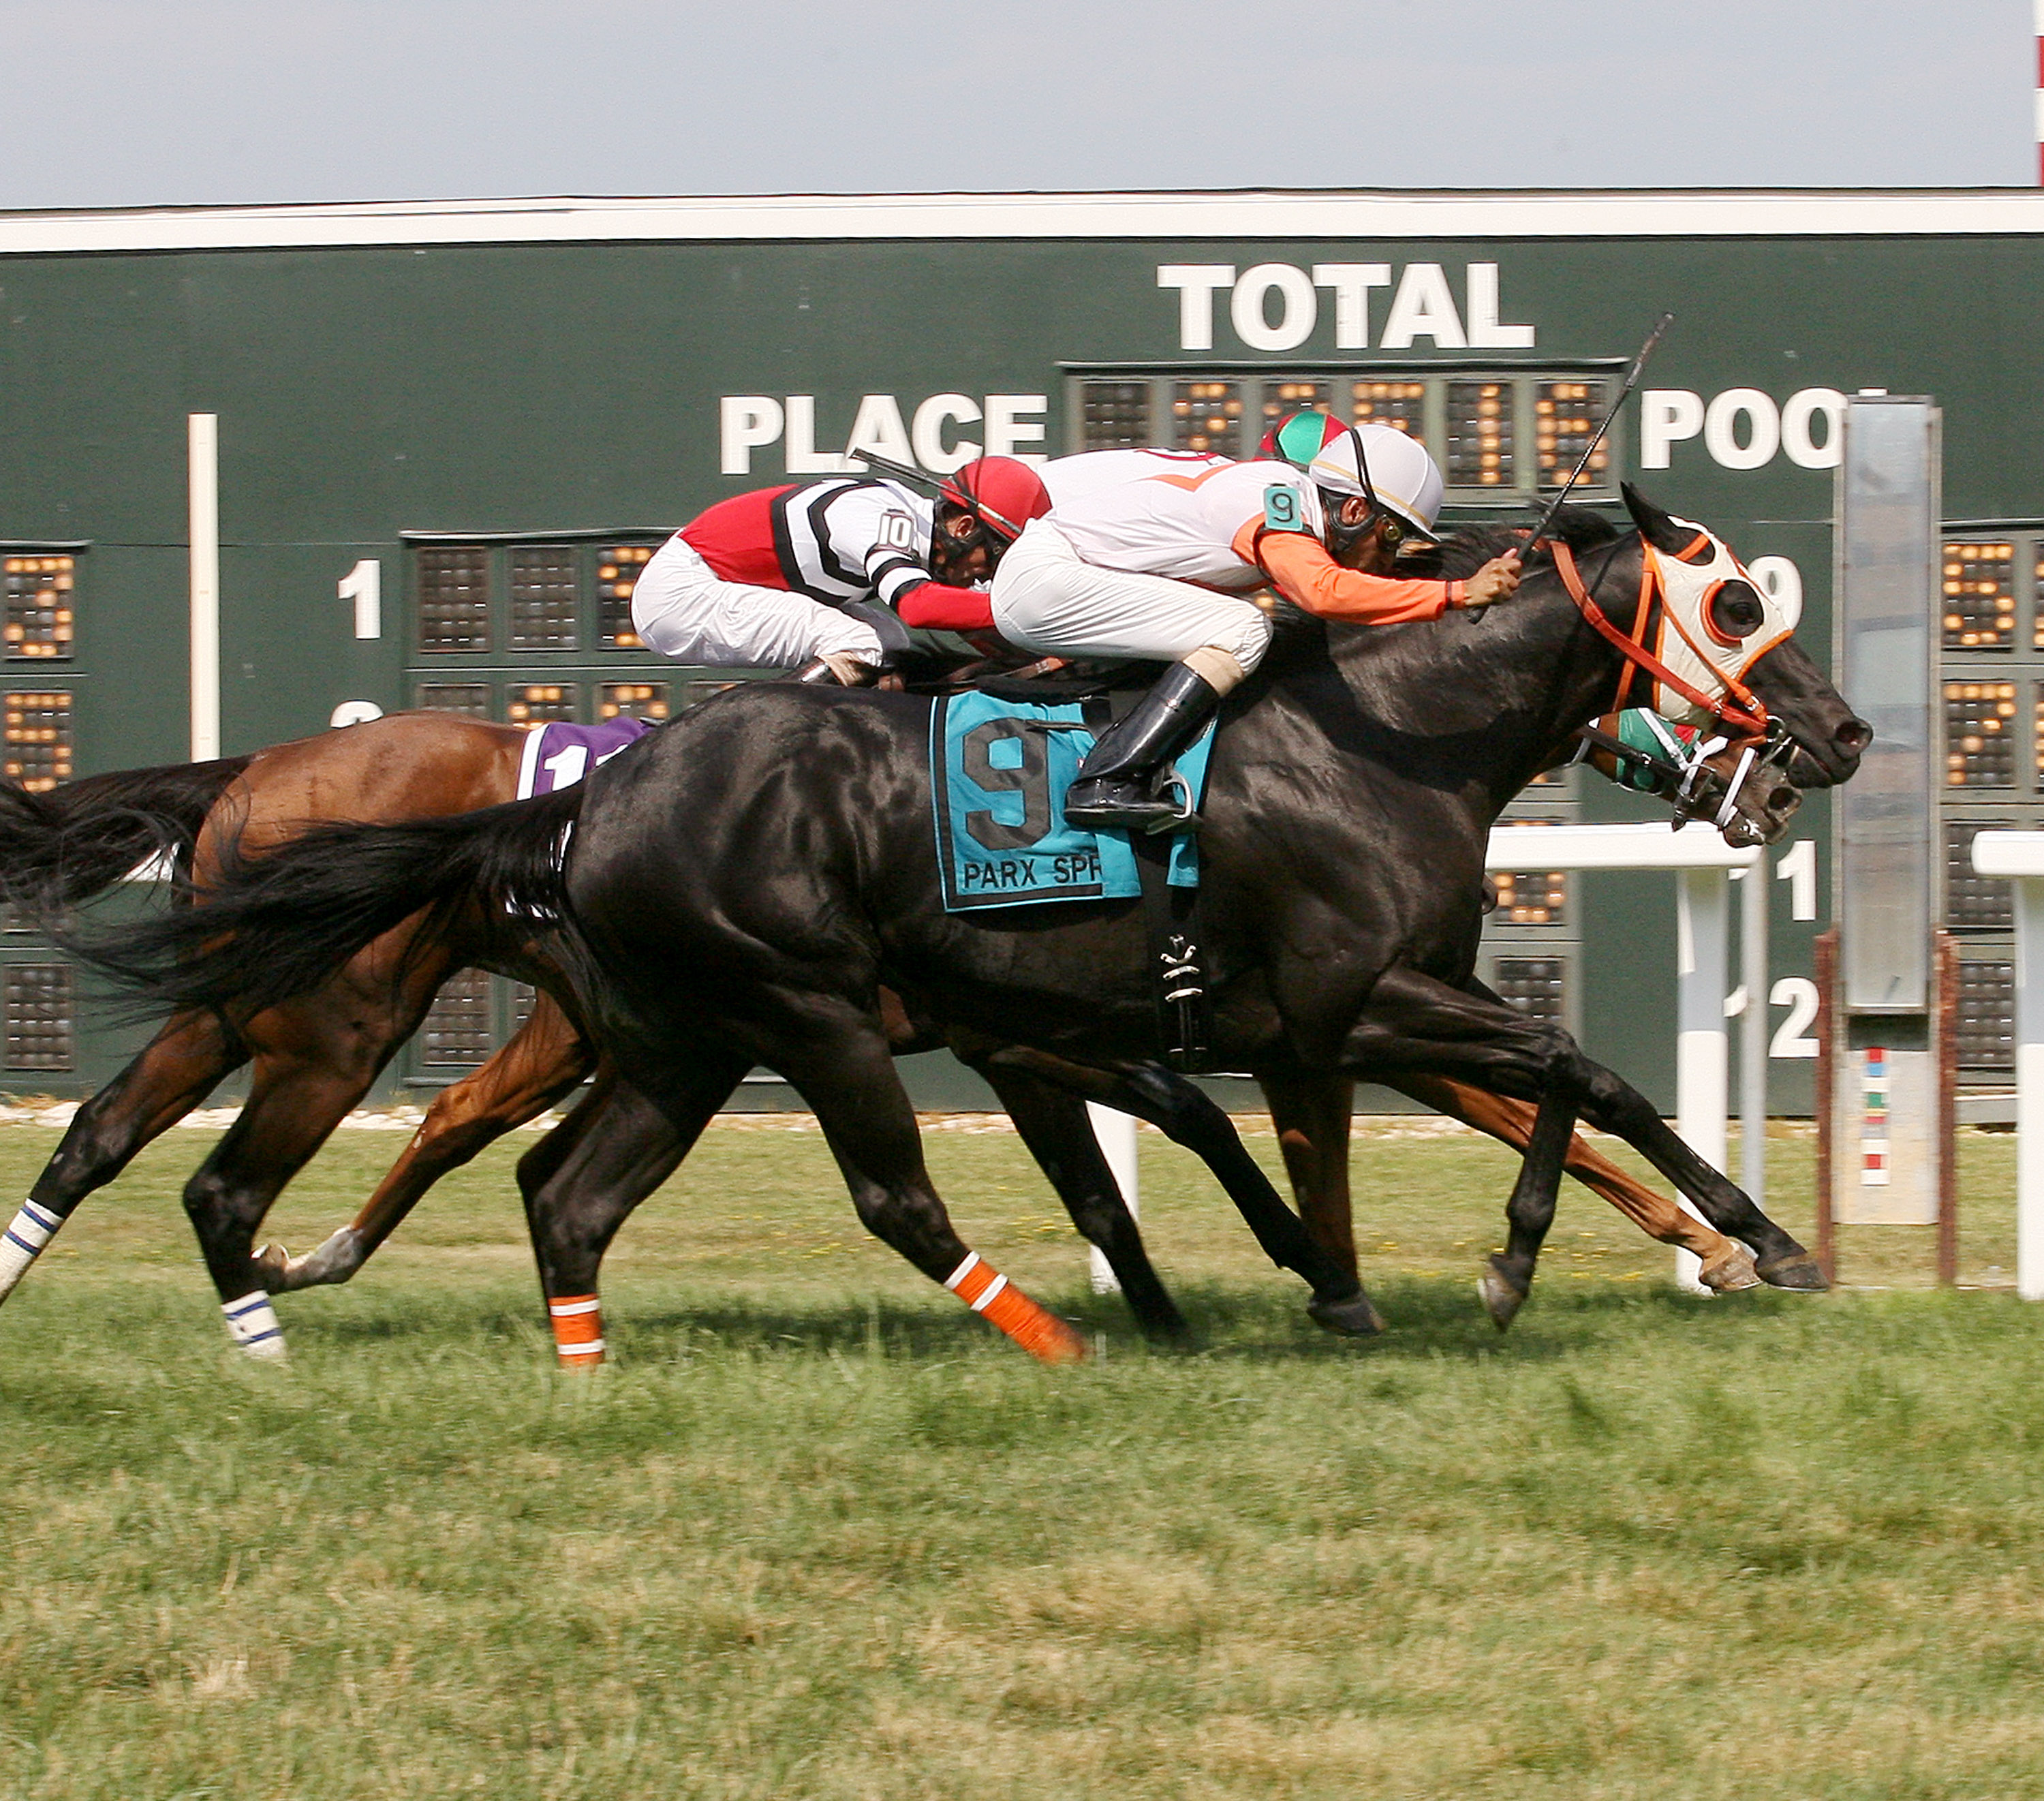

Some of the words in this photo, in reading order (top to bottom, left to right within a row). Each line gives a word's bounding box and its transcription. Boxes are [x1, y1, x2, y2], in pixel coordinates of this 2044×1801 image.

[1158, 262, 1536, 352] TOTAL
[720, 392, 1049, 475] PLACE
[1641, 386, 1889, 470] POO
[878, 514, 912, 549] 10
[1272, 493, 1293, 522] 9
[337, 559, 380, 639] 1
[963, 717, 1051, 850] 9
[963, 858, 1038, 889] PARX
[1728, 840, 1816, 921] 1
[1722, 976, 1821, 1058] 2
